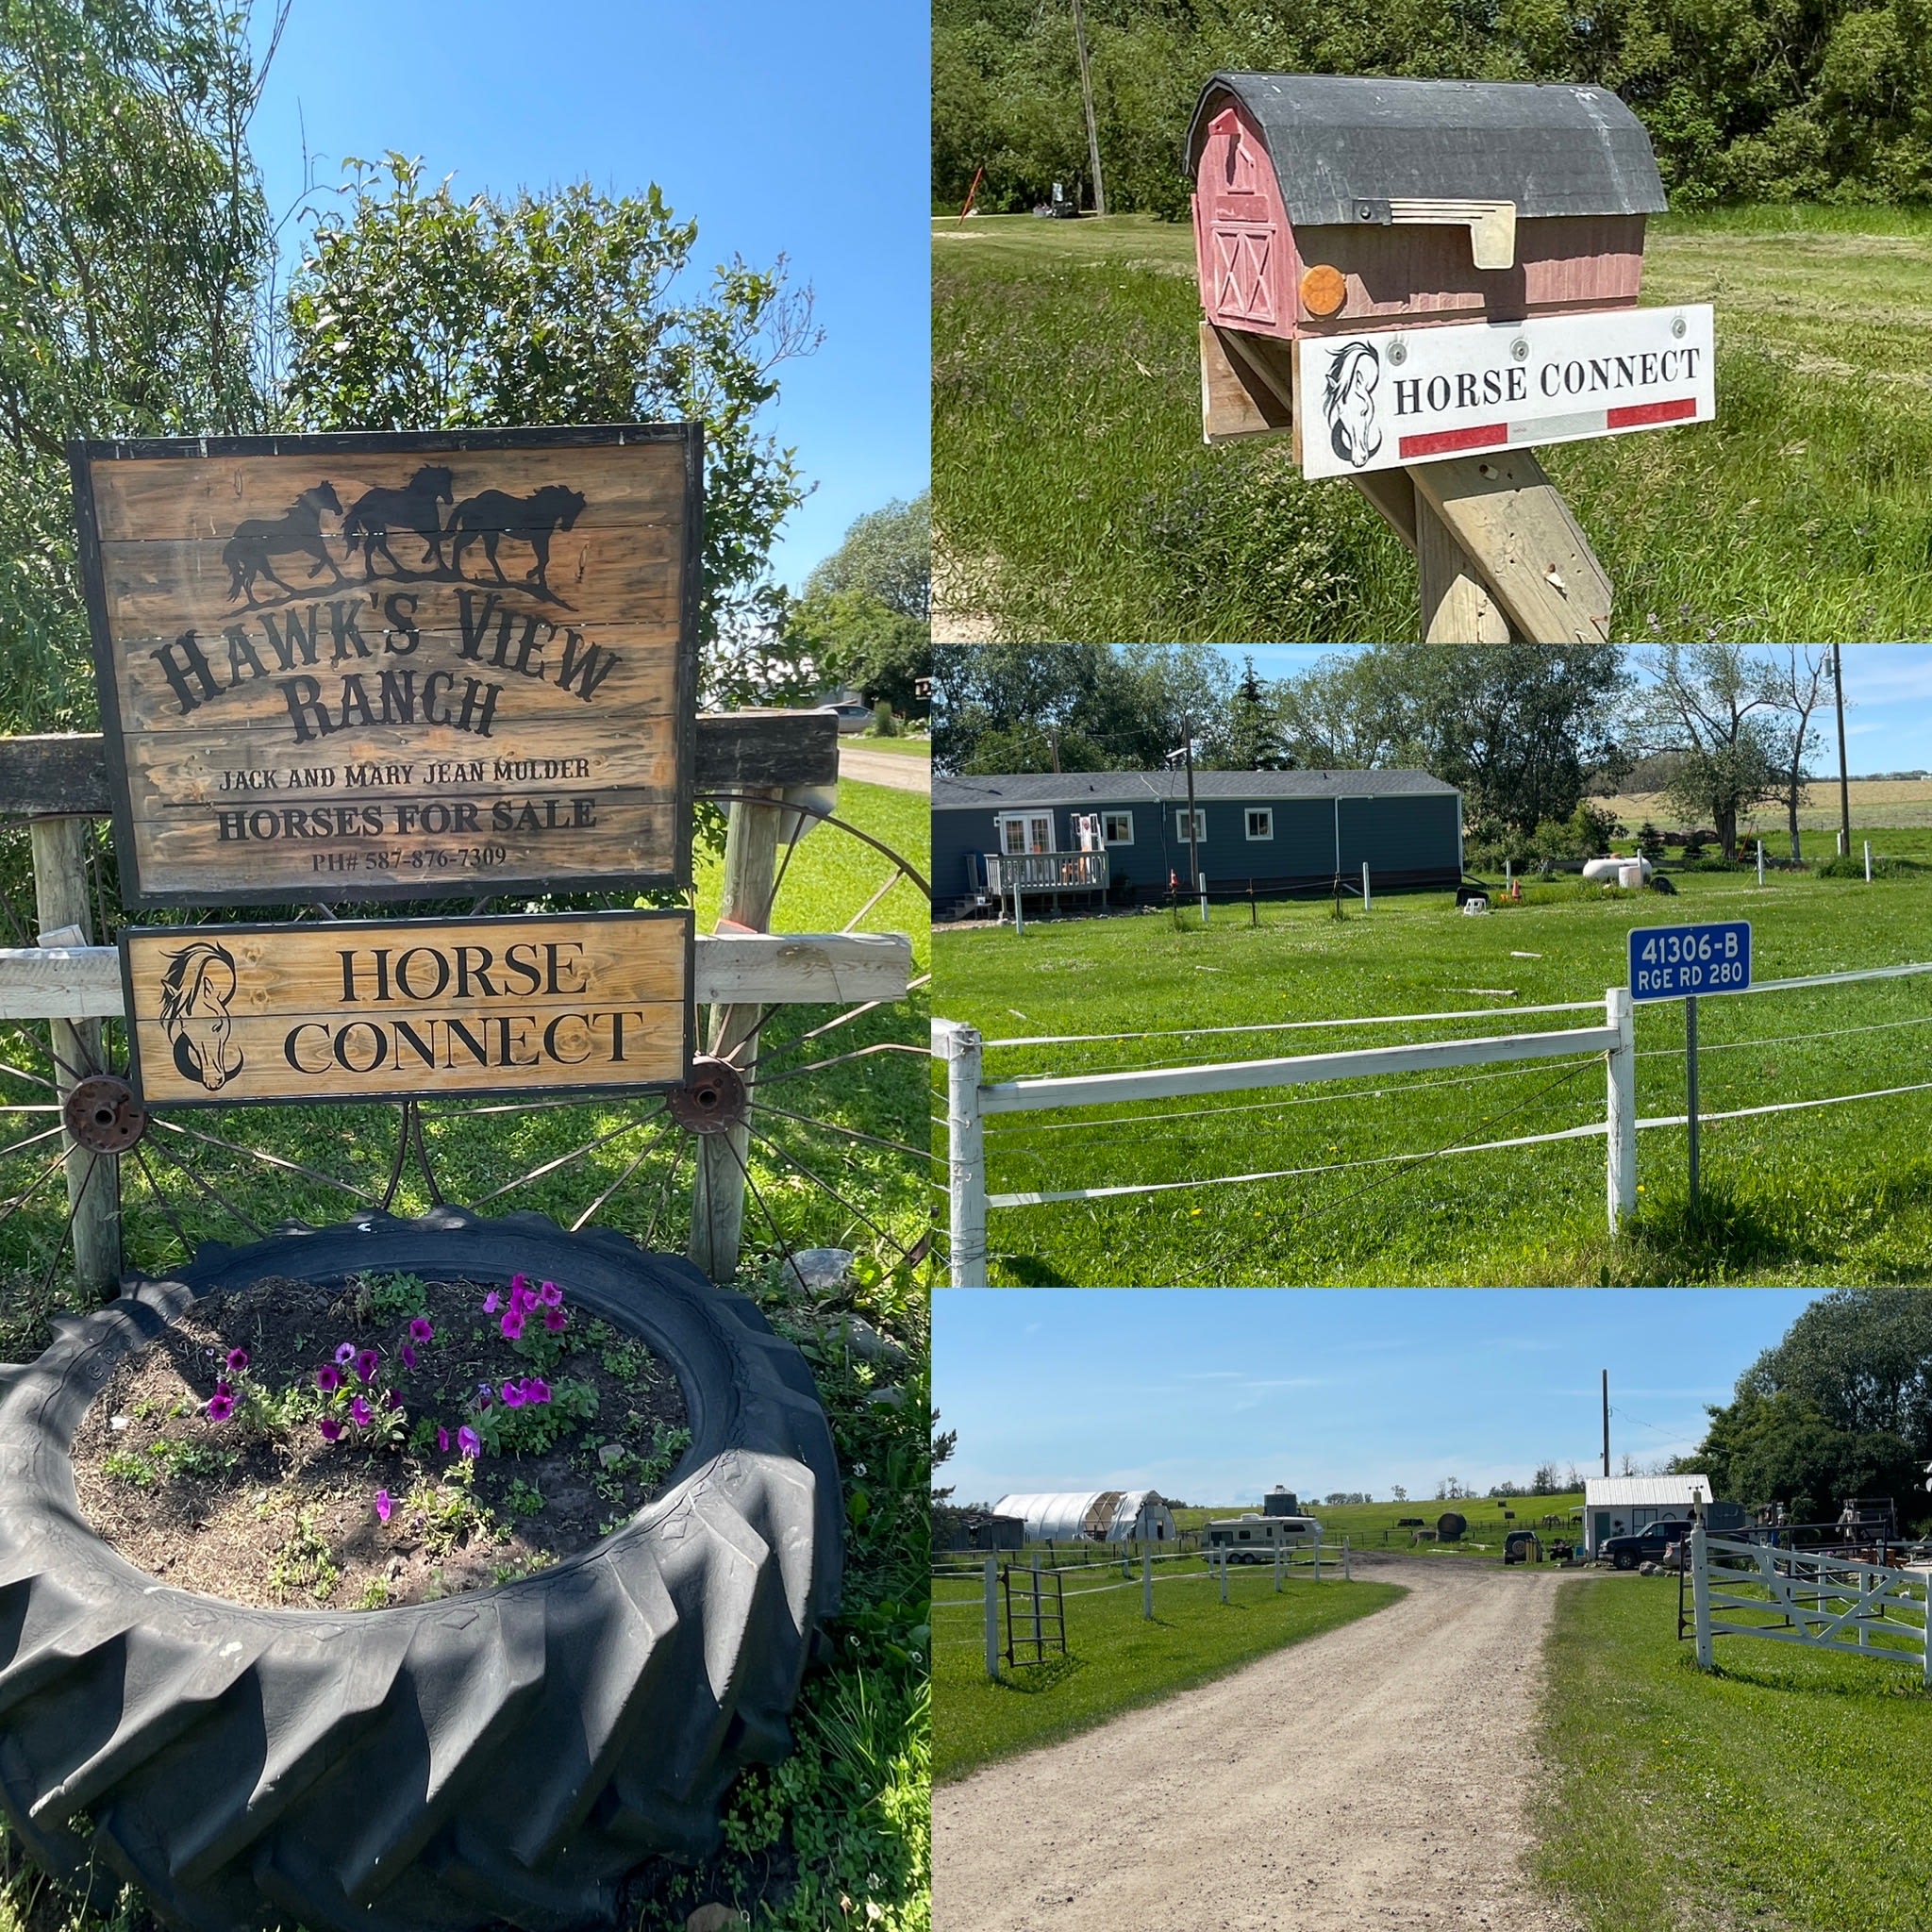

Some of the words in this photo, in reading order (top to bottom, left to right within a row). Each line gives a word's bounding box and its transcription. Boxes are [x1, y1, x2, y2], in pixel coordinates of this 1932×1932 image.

[1392, 367, 1526, 416] HORSE
[1540, 347, 1700, 397] CONNECT
[149, 592, 421, 716] HAWK'S
[454, 589, 623, 703] VIEW
[276, 669, 506, 744] RANCH
[219, 770, 279, 791] JACK
[288, 767, 335, 789] AND
[343, 764, 412, 789] MARY
[422, 762, 484, 785] JEAN
[493, 758, 590, 781] MULDER
[216, 808, 384, 841] HORSES
[393, 802, 482, 835] FOR
[491, 797, 597, 832] SALE
[311, 853, 358, 874] PH#
[365, 847, 508, 872] 587-876-7309
[336, 942, 587, 1002] HORSE
[1641, 932, 1738, 964] 41306-B
[1639, 968, 1674, 991] RGE
[1680, 965, 1702, 987] RD
[1709, 961, 1742, 984] 280
[284, 1010, 643, 1074] CONNECT
